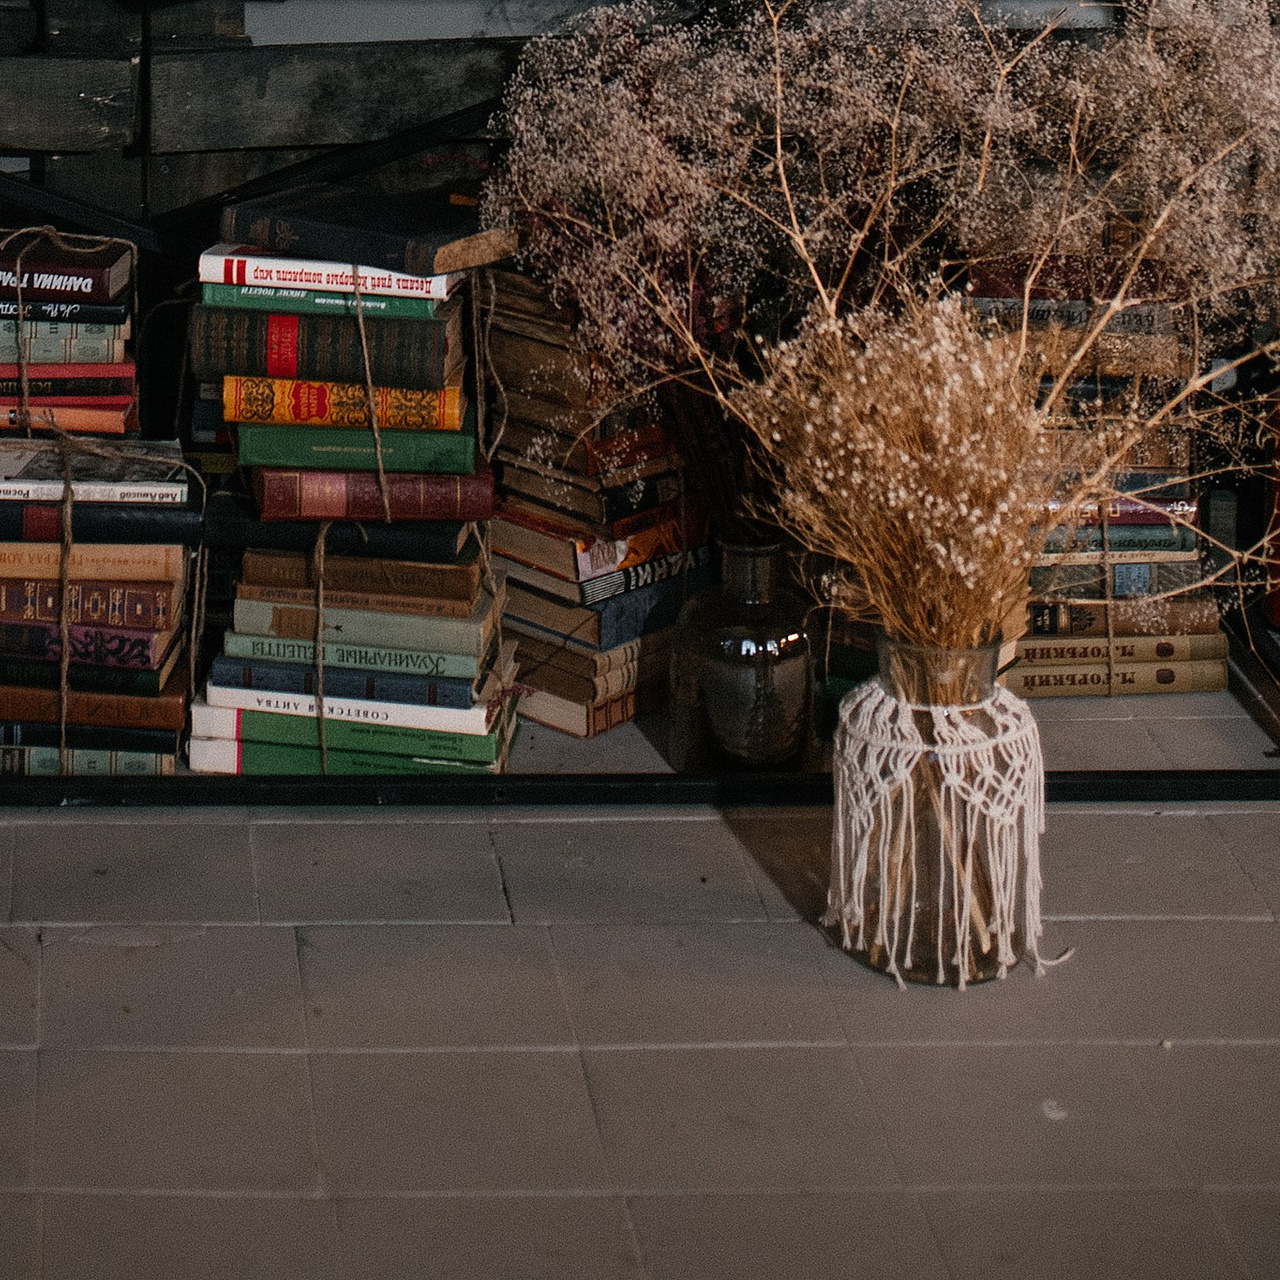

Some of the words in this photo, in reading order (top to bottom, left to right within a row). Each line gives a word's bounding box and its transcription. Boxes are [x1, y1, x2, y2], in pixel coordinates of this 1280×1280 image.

[254, 266, 273, 282] мир
[276, 269, 323, 284] потрясли
[34, 273, 93, 293] ДАНИИЛ
[371, 274, 392, 291] дней
[396, 278, 432, 294] Десять
[158, 492, 178, 501] Лев
[27, 553, 84, 565] ГЕЕРАЛ
[1024, 646, 1111, 662] ГОРЬКИЙ
[1116, 644, 1134, 658] М.
[336, 648, 445, 675] КУЛИНАРНЫЕ
[1022, 674, 1111, 690] ГОРЬКИЙ
[1116, 672, 1136, 685] М.
[256, 697, 299, 711] ЛИТВА
[308, 704, 389, 720] СОВЕТСКЯ
